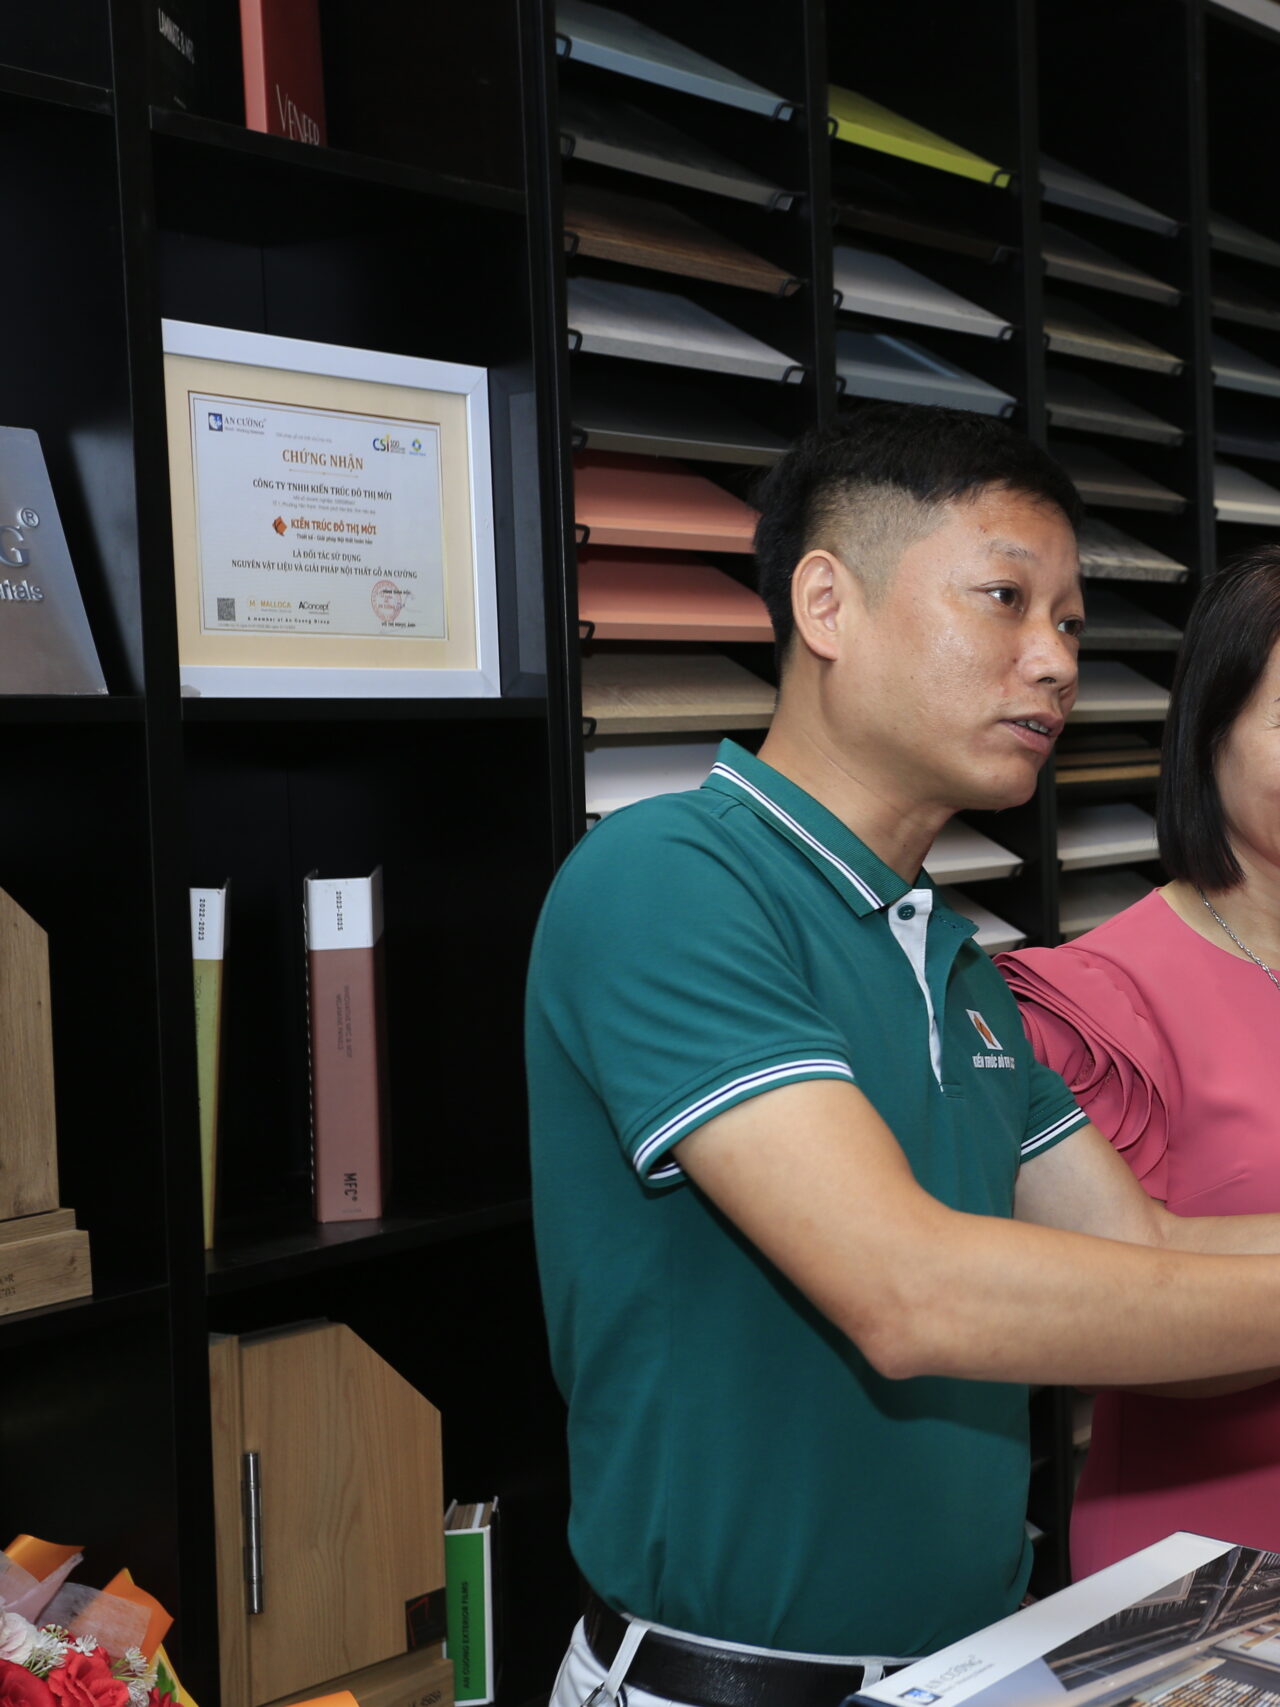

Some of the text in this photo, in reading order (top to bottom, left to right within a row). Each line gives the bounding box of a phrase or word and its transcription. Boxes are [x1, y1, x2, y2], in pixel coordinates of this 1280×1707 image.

[282, 448, 364, 472] CHỨNG NHẬN
[253, 478, 274, 489] CÔNG
[276, 481, 285, 491] TY
[287, 482, 309, 493] TNHH
[331, 484, 350, 496] TRÚC
[351, 488, 362, 497] ĐÔ
[364, 490, 376, 500] THỊ
[377, 490, 392, 500] MỚI
[312, 518, 332, 532] TRÚC
[333, 520, 345, 532] ĐÔ
[347, 524, 360, 537] THỊ
[361, 522, 377, 535] MỚI
[293, 549, 302, 558] LÀ
[303, 549, 316, 559] ĐỐI
[317, 550, 330, 560] TÁC
[342, 552, 361, 563] DỤNG
[231, 558, 261, 569] NGUYÊN
[262, 559, 274, 570] VẬT
[277, 561, 293, 572] LIỆU
[294, 562, 304, 572] VÀ
[320, 563, 339, 574] PHÁP
[340, 565, 353, 576] NỘI
[354, 565, 371, 576] THẤT
[373, 566, 383, 577] GỖ
[384, 568, 393, 577] AN
[394, 568, 417, 579] CƯỜNG
[260, 600, 292, 608] MALLOCA
[198, 898, 206, 941] 2022-2023
